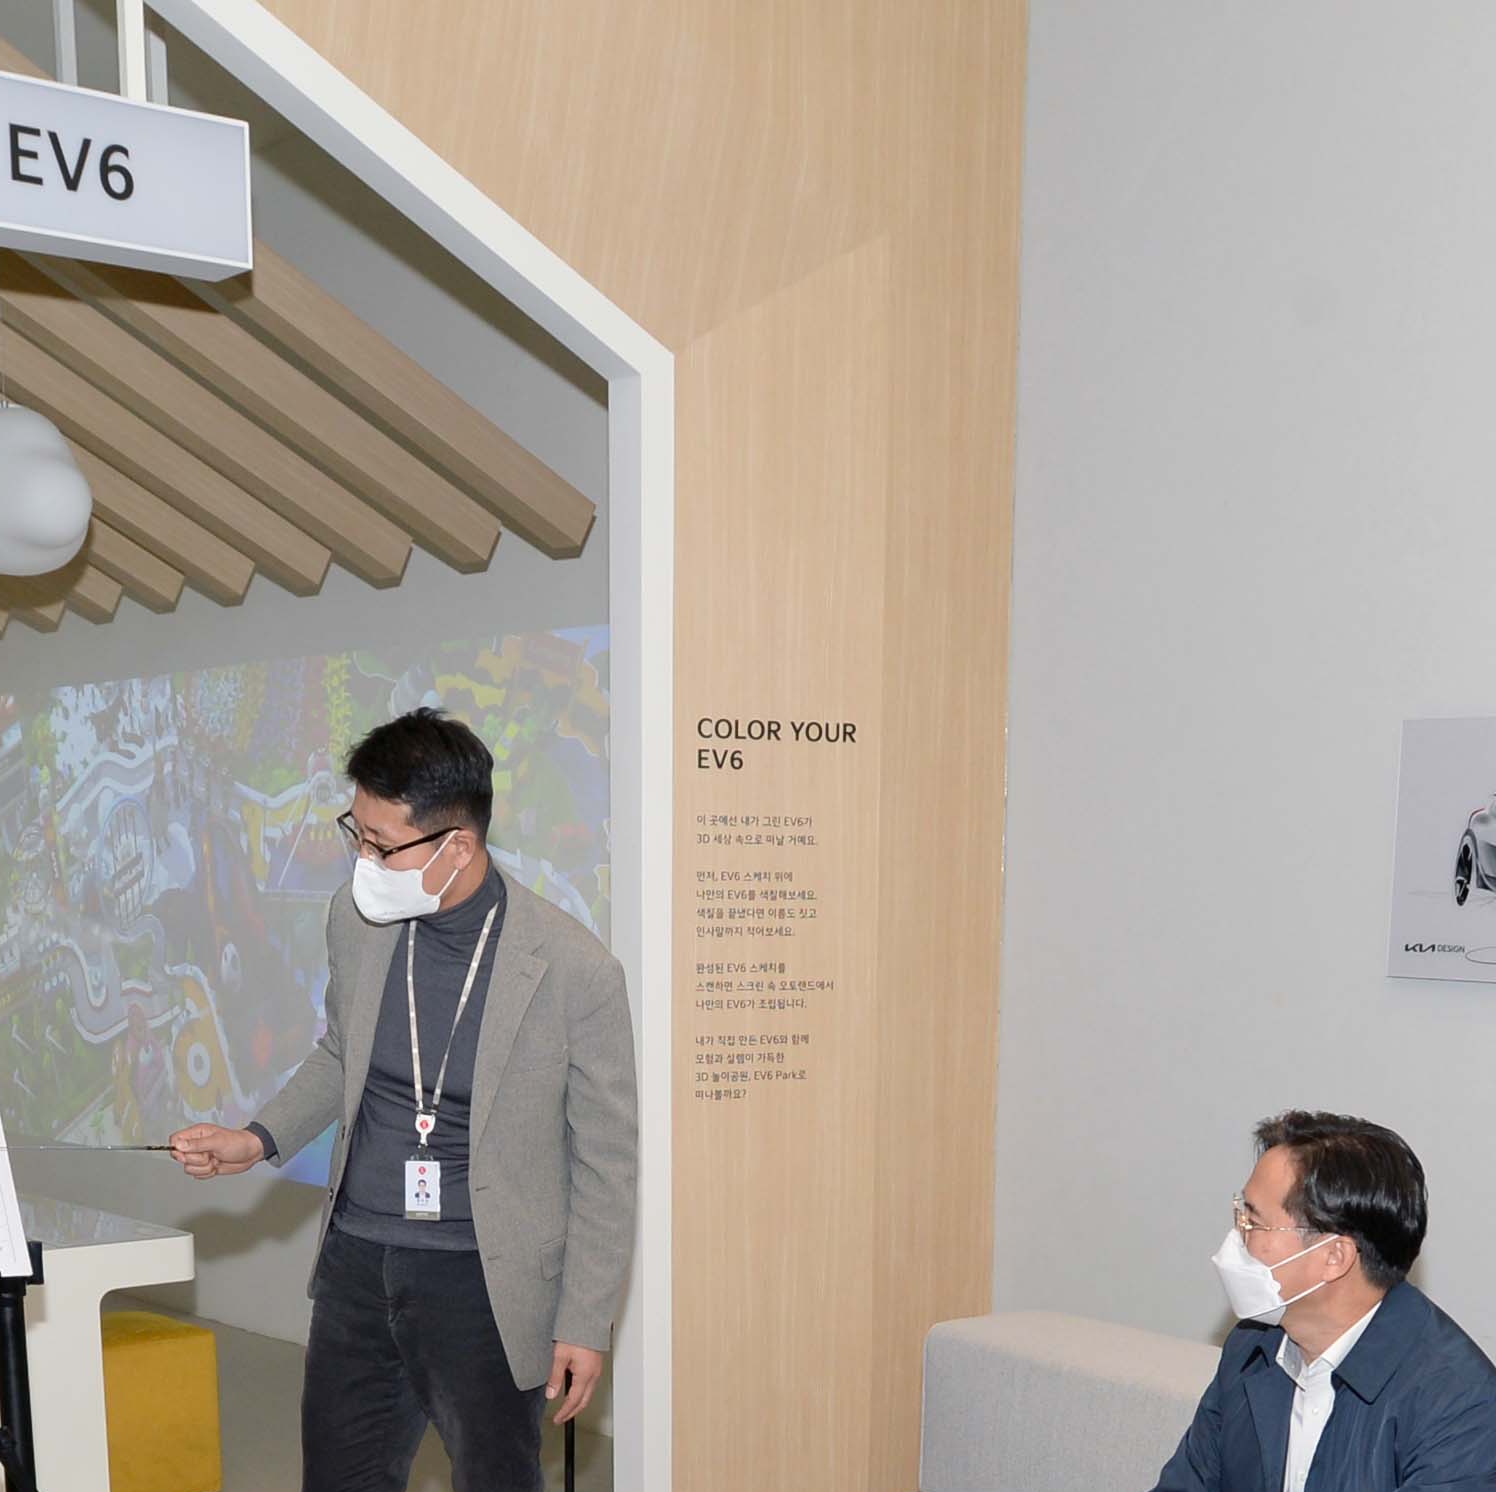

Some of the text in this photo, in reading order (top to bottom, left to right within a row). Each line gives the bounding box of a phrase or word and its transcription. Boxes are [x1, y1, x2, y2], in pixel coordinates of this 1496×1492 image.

[8, 123, 136, 201] EV6
[696, 718, 857, 744] COLOR YOUR
[696, 749, 744, 770] EV6
[696, 813, 706, 826] 이
[740, 815, 760, 827] 내가
[762, 815, 781, 828] 그린
[783, 816, 813, 828] EV6가
[696, 833, 710, 844] 3D
[714, 834, 732, 846] 세상
[735, 834, 764, 846] 속으로
[720, 871, 741, 882] EV6
[743, 871, 771, 883] 스케치
[774, 871, 793, 883] 위에
[696, 889, 724, 901] 나만의
[727, 889, 756, 901] EV6를
[696, 907, 724, 920] 색칠을
[767, 907, 795, 920] 이름도
[695, 925, 743, 938] 인사말까지
[695, 962, 786, 975] 완성된 EV6 스케치를
[695, 981, 733, 992] 스캔하면
[735, 981, 764, 992] 스크린
[767, 981, 776, 992] 속
[695, 999, 724, 1010] 나만의
[726, 999, 755, 1010] EV6가
[695, 1035, 714, 1046] 내가
[738, 1035, 758, 1046] 만든
[759, 1034, 788, 1046] EV6와
[695, 1053, 723, 1065] 모험과
[756, 1051, 785, 1064] 가득한
[695, 1071, 709, 1082] 3D
[753, 1070, 774, 1081] EV6
[775, 1069, 808, 1081] Park로
